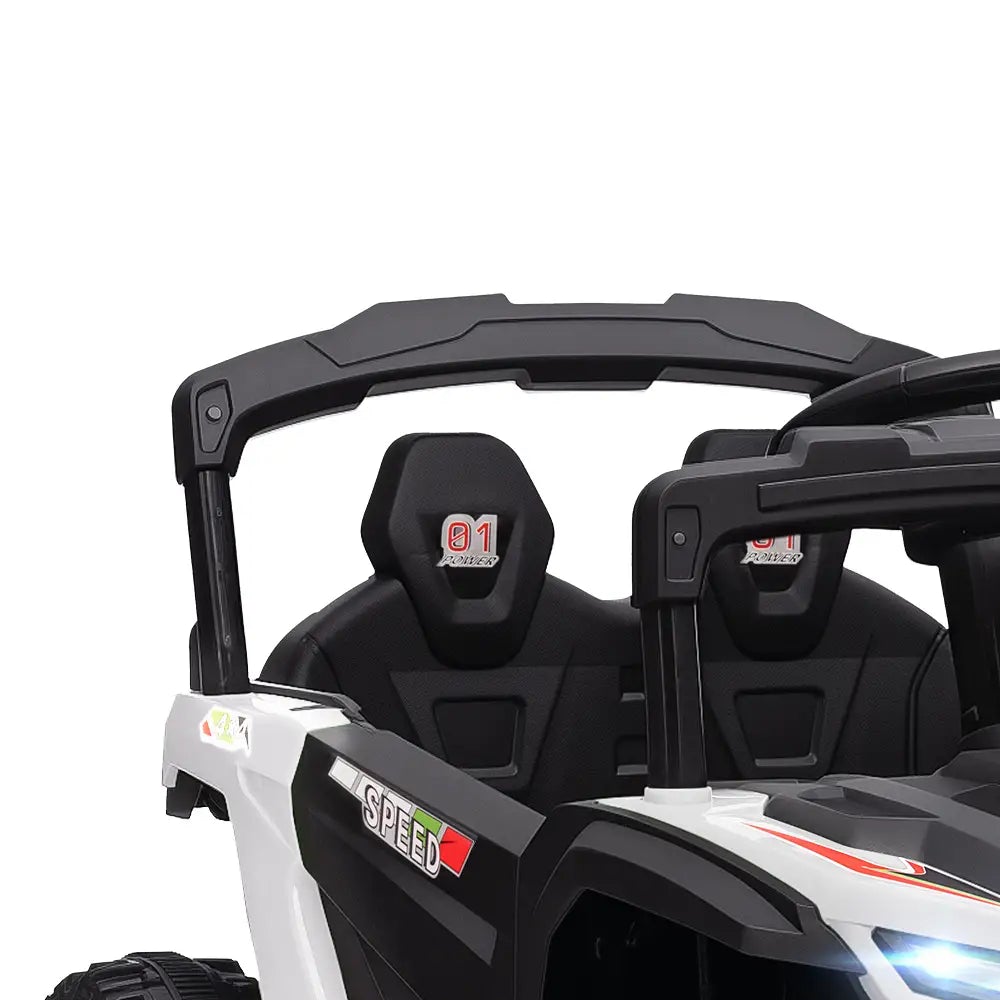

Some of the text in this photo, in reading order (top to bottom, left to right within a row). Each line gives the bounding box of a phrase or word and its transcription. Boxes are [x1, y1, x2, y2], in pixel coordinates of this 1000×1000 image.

[447, 520, 491, 553] 01
[440, 554, 498, 566] POWER
[743, 552, 801, 563] POWER
[363, 784, 441, 876] SPEED
